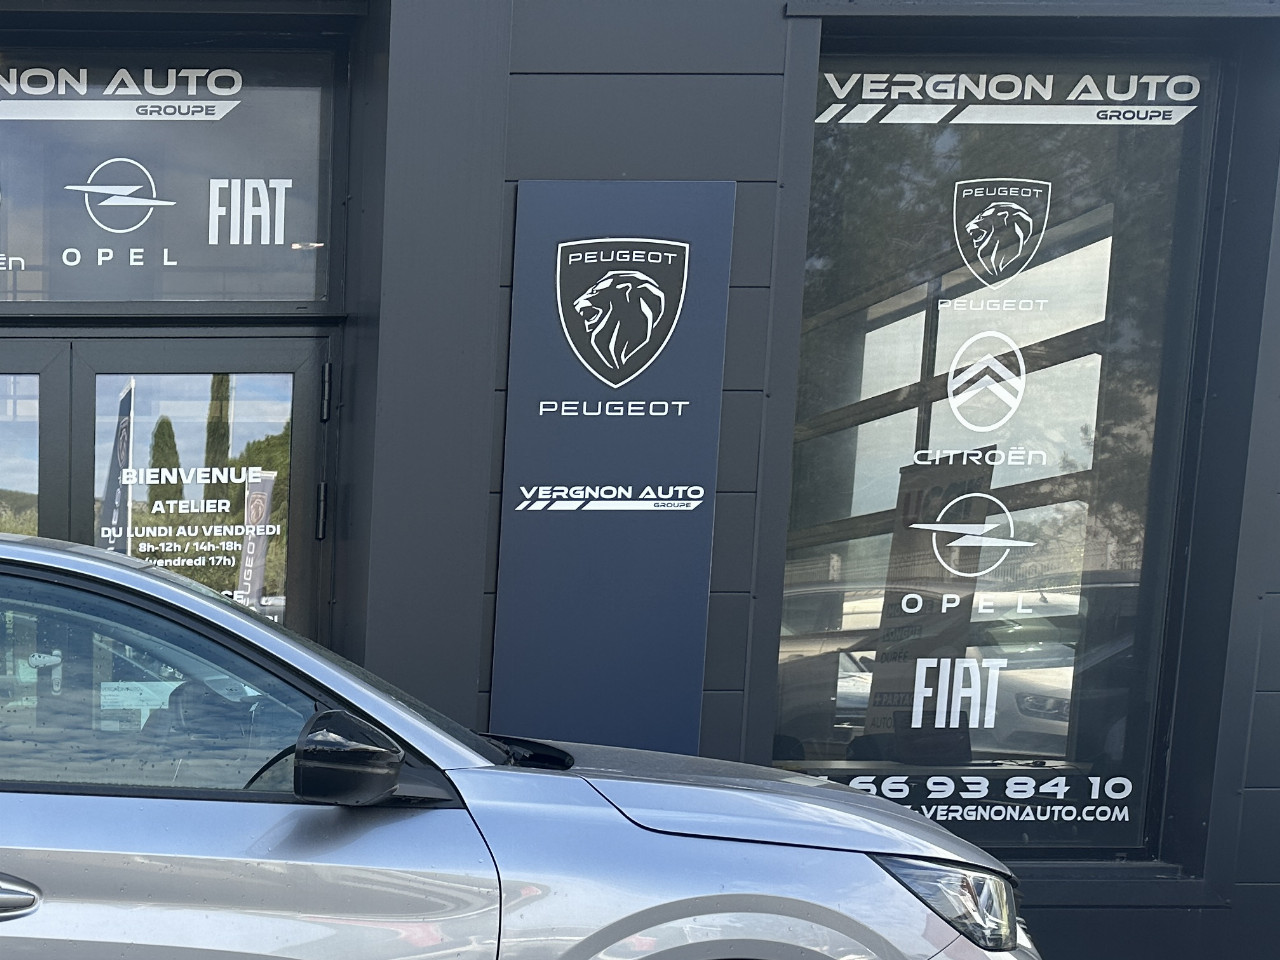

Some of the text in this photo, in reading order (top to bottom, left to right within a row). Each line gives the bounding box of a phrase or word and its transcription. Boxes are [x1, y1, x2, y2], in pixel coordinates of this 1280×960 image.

[103, 68, 243, 96] AUTO
[823, 73, 1201, 101] VERGNON AUTO
[136, 104, 216, 116] GROUPE
[1096, 109, 1173, 121] GROUPE
[962, 186, 1043, 198] PEUGEOT
[208, 179, 293, 245] FIAT
[63, 248, 178, 267] OPEL
[568, 250, 677, 265] PEUGEOT
[937, 299, 1049, 311] PEUGEOT
[539, 401, 690, 416] PEUGEOT
[913, 447, 1047, 466] CITROËN
[121, 467, 262, 485] BIENVENUE
[519, 486, 705, 499] VERGNON AUTO
[151, 500, 230, 514] ATELIER
[100, 525, 281, 538] DU LUNDI AU VENDREDI
[138, 542, 182, 553] 8h-12h
[192, 541, 242, 552] 14h-18h
[208, 556, 236, 568] 17h)
[901, 593, 1033, 614] OPEL
[911, 658, 1008, 729] FIAT
[926, 776, 989, 799] 93
[1005, 776, 1070, 799] 84
[1088, 776, 1133, 800] 10
